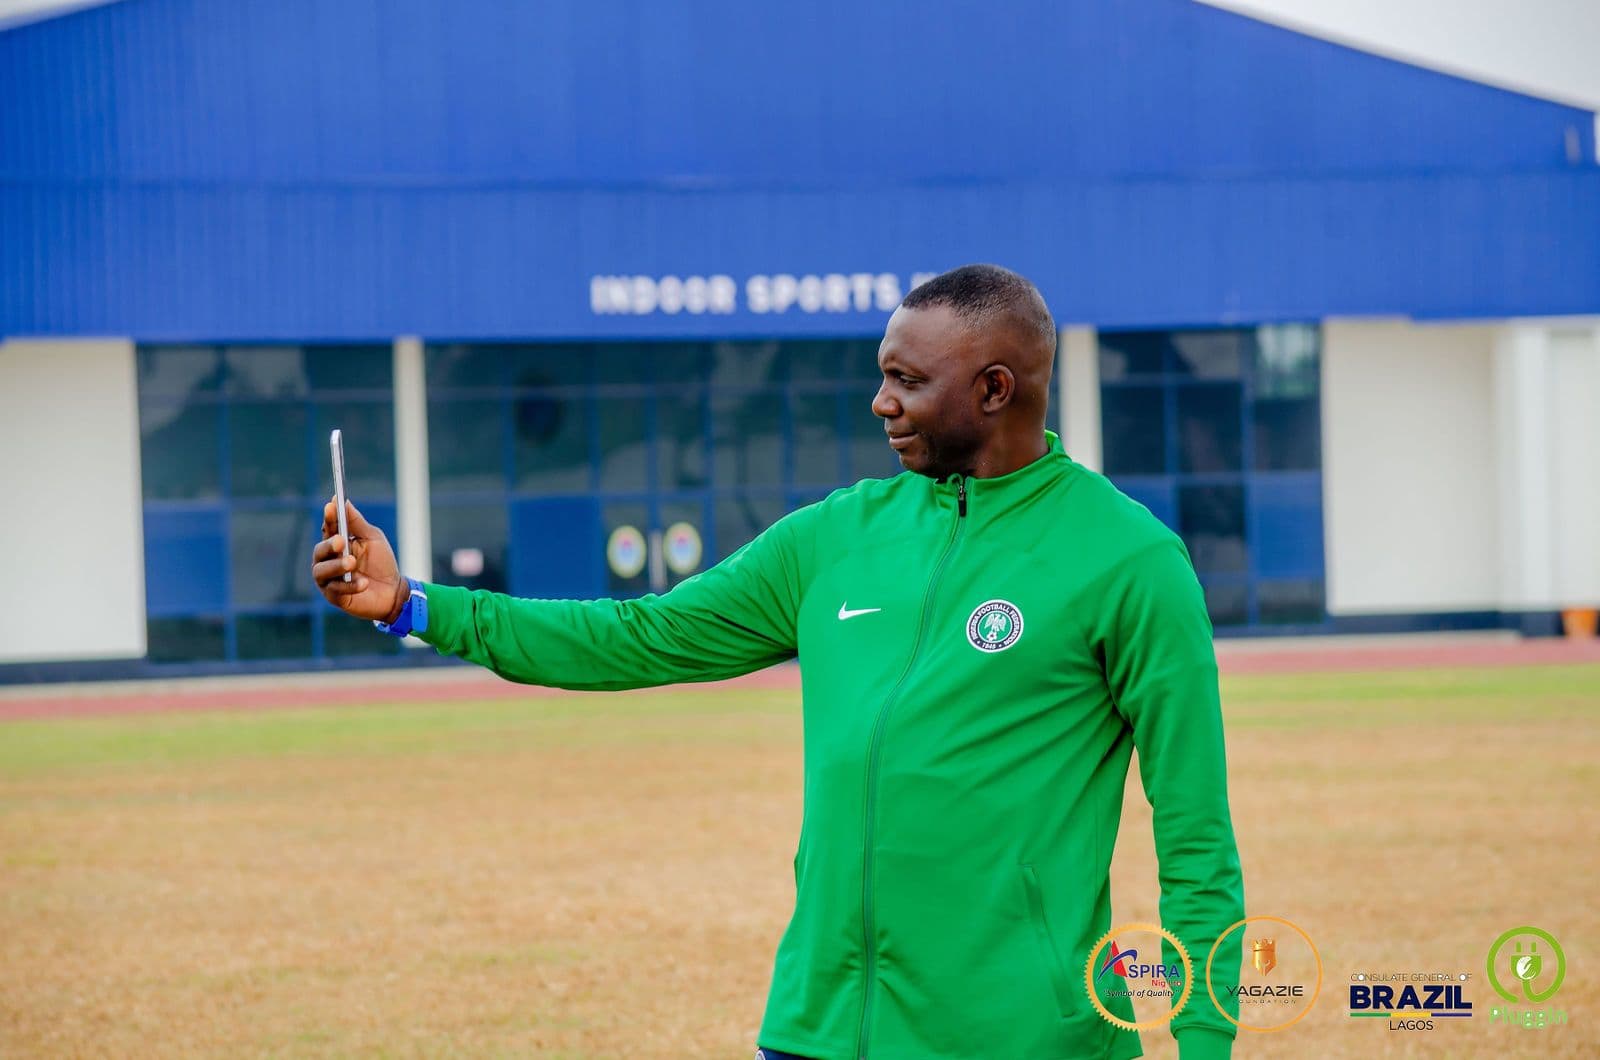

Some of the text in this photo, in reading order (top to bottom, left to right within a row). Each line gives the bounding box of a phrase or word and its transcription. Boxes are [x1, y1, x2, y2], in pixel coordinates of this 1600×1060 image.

[591, 275, 736, 314] INDOOR
[747, 273, 899, 312] SPORTS
[977, 604, 1010, 617] FOOTBALL
